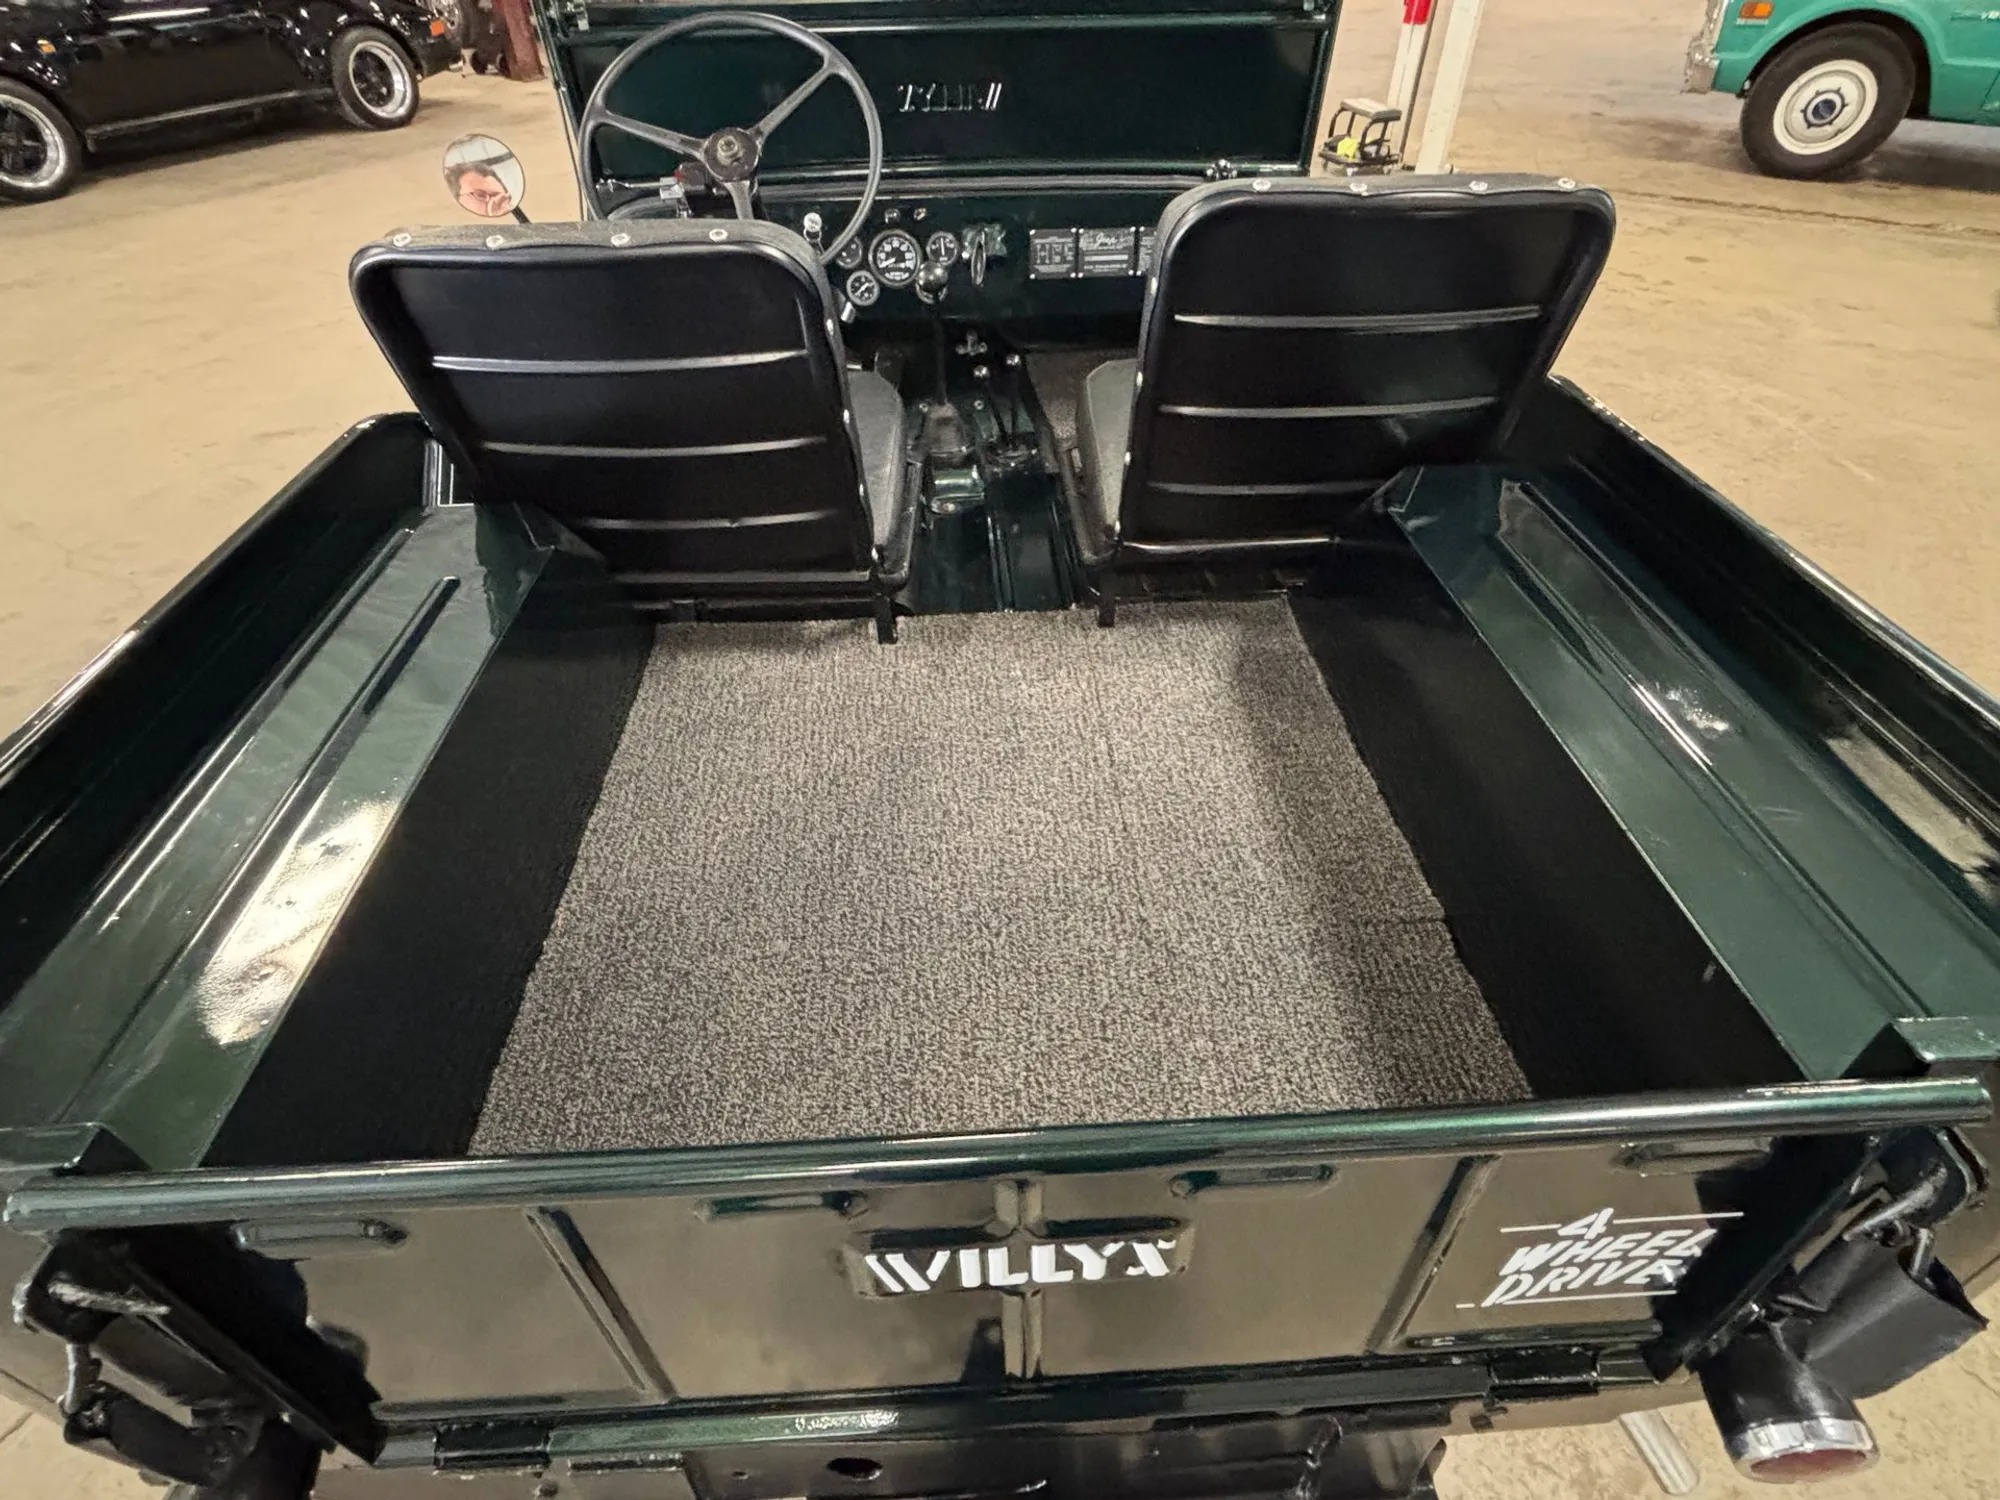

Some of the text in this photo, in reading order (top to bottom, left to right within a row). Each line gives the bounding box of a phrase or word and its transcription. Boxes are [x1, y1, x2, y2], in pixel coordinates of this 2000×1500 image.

[1557, 1207, 1614, 1241] 4
[865, 1240, 1177, 1292] WILLYS
[1499, 1228, 1716, 1276] WHEEL
[1481, 1258, 1685, 1307] DRIVE
